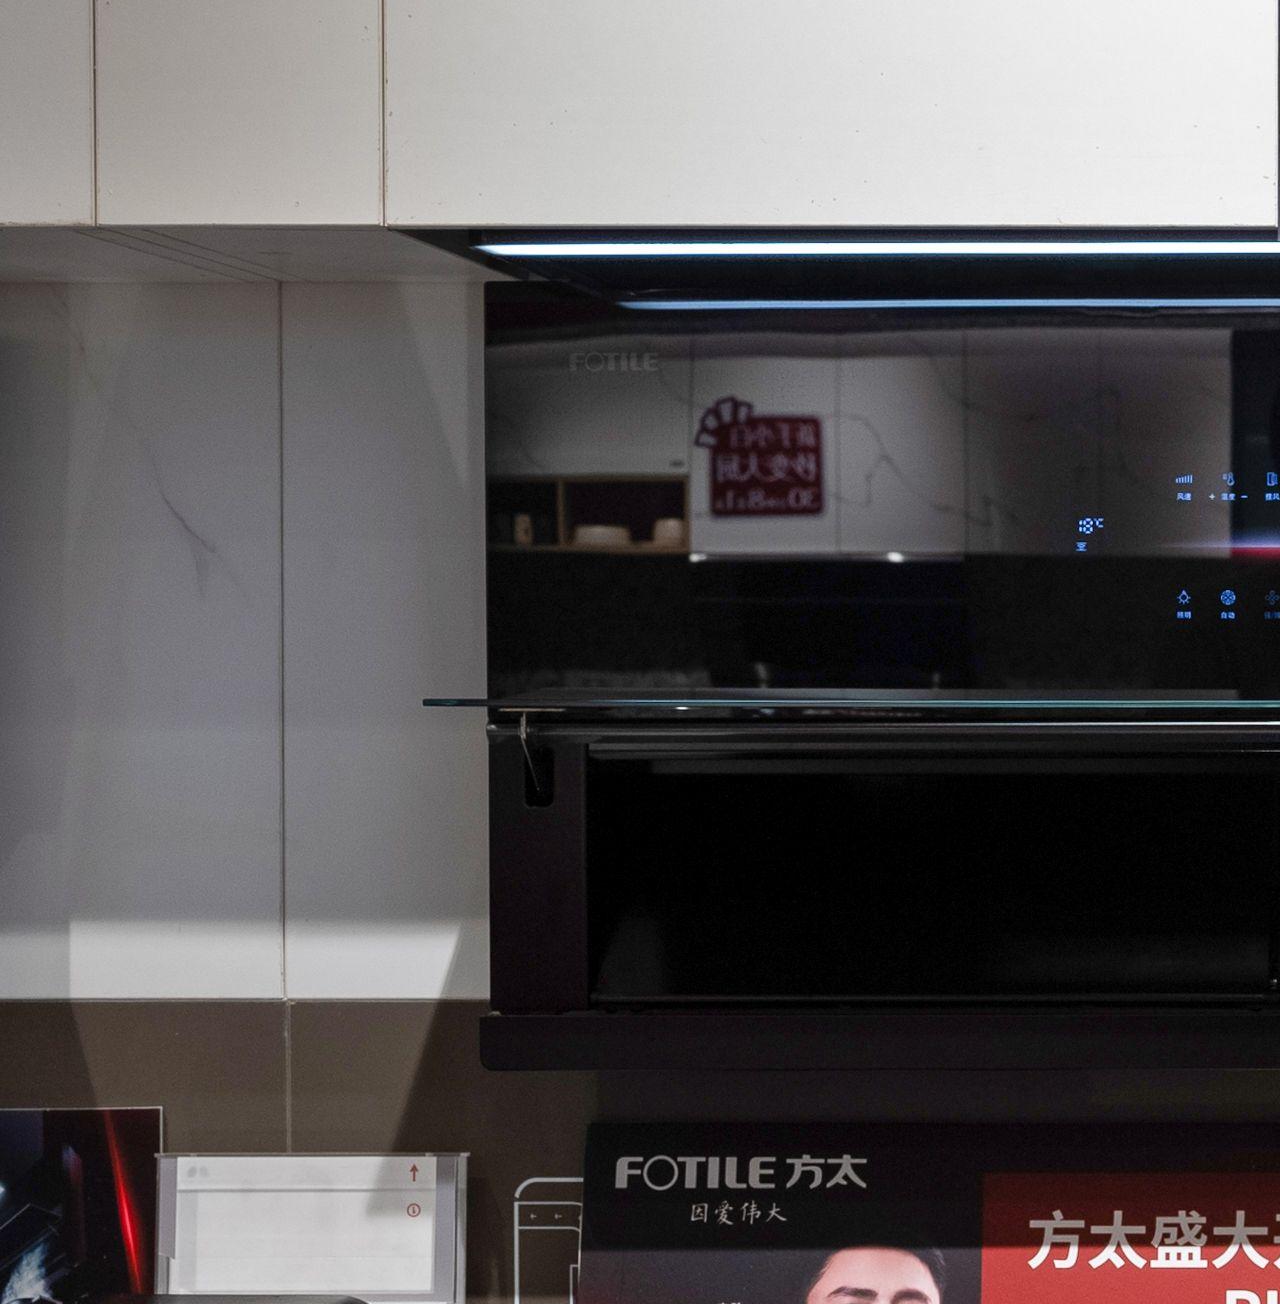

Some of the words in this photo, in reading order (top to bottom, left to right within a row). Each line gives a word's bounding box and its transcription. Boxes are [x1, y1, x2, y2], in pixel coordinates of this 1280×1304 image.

[615, 1155, 776, 1191] FOTILE
[786, 1154, 868, 1189] 方太
[690, 1200, 788, 1226] 因爱伟大
